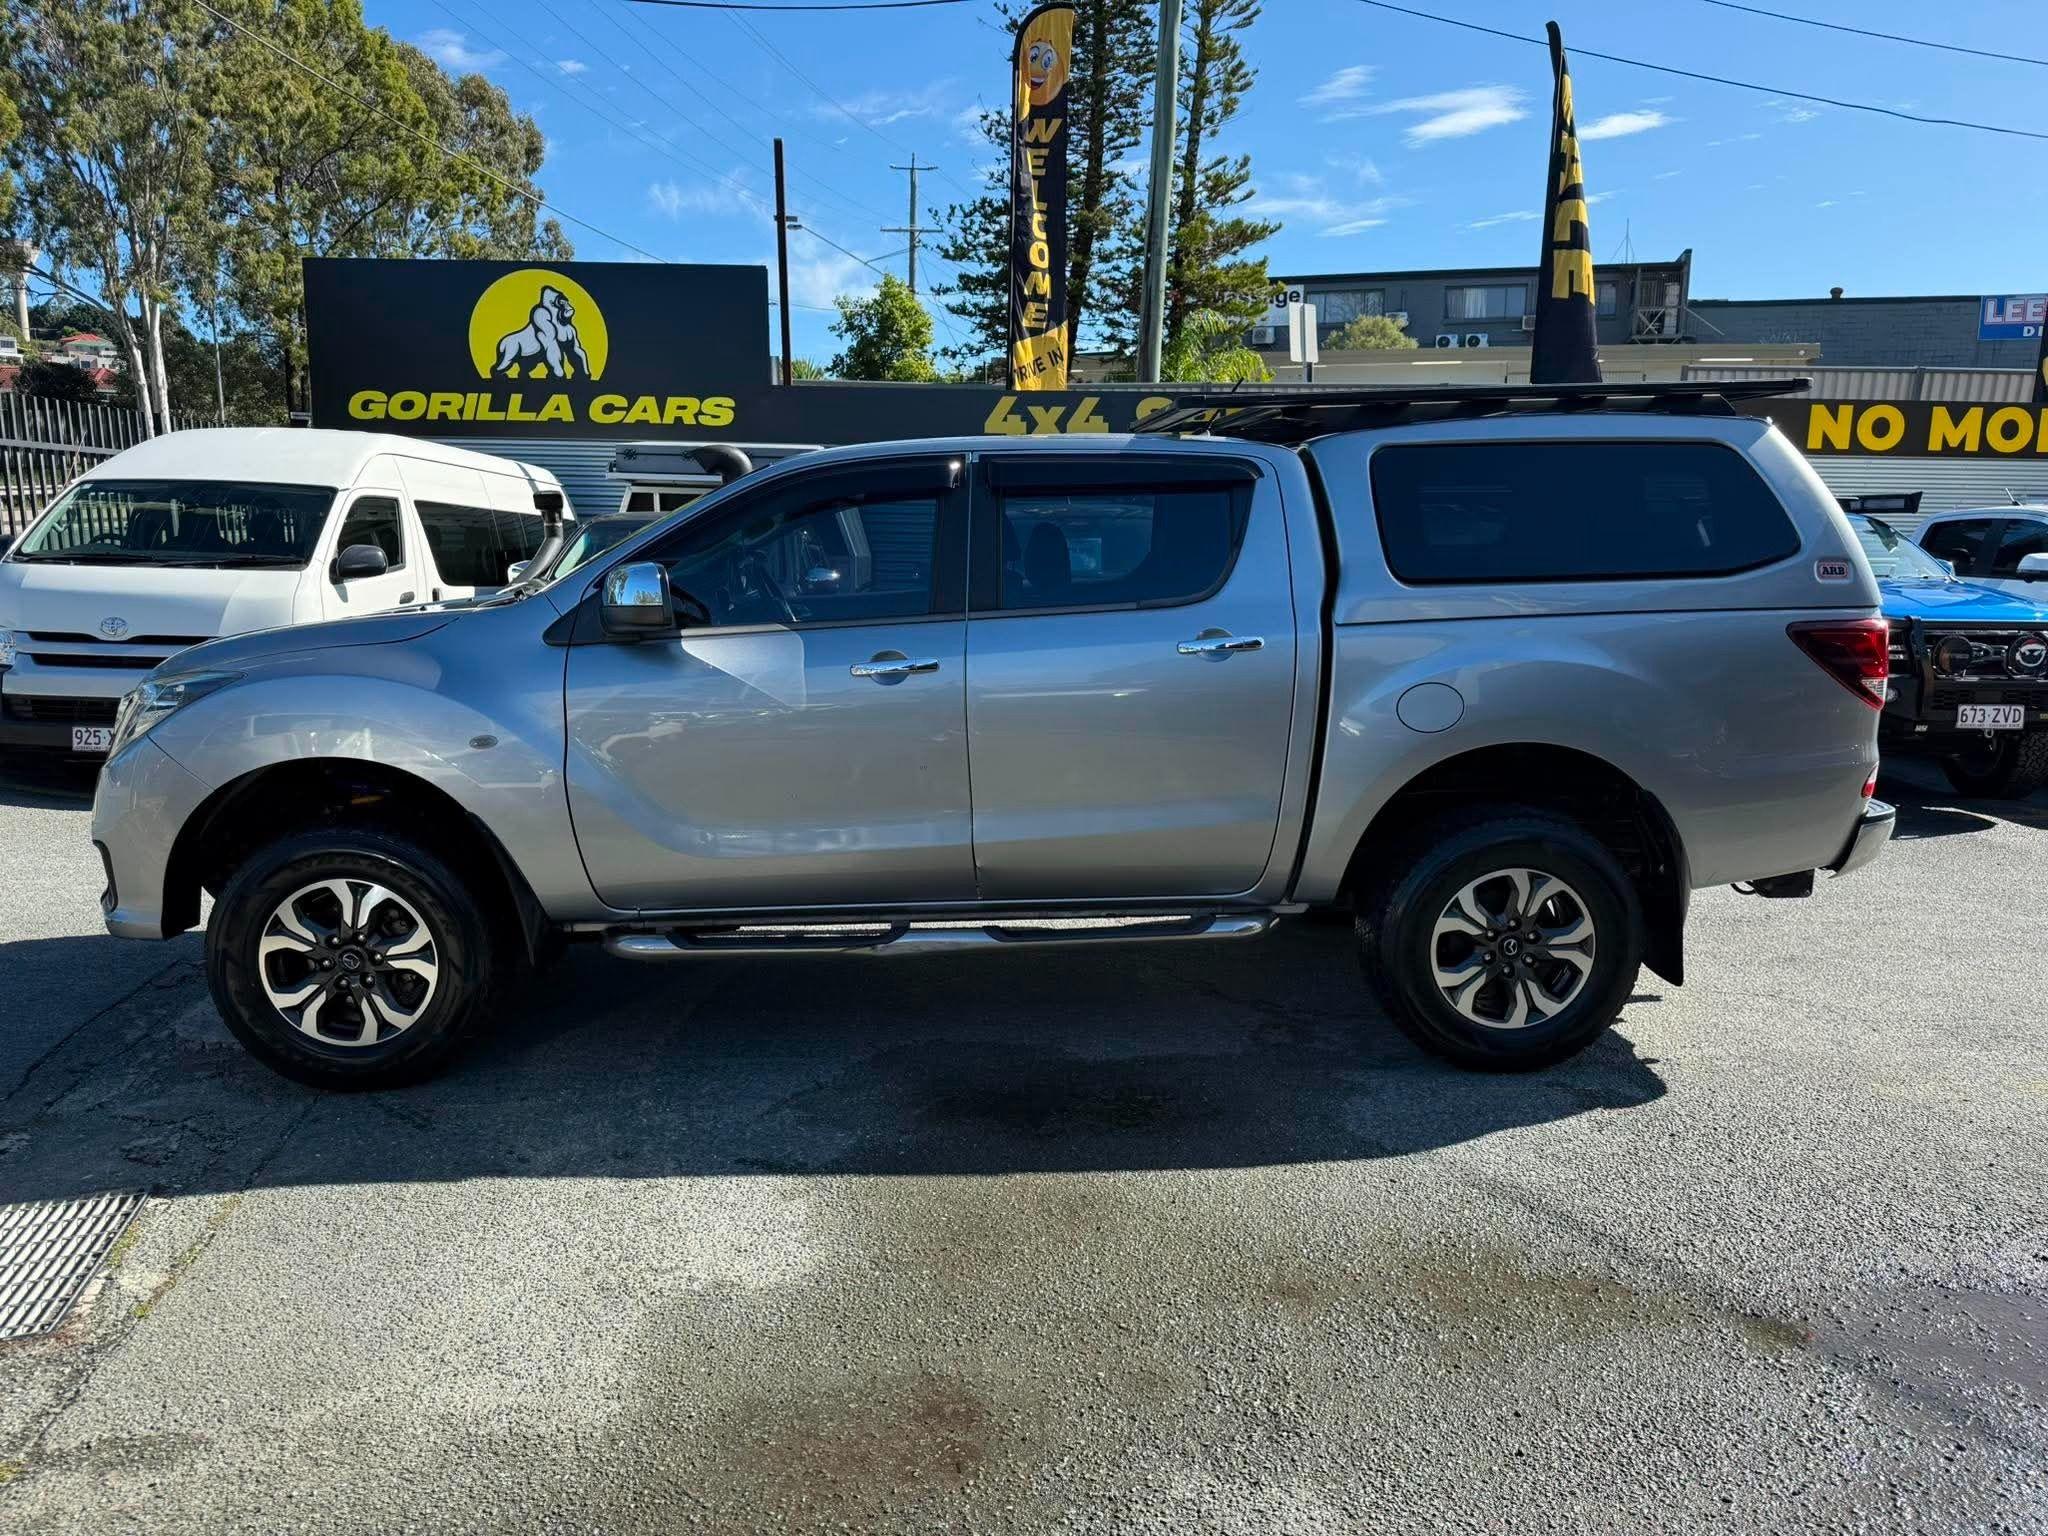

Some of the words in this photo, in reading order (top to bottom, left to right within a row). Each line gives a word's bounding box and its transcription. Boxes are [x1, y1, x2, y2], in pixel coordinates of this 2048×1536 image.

[1023, 118, 1062, 329] WELCOME
[1047, 346, 1064, 367] IN
[348, 390, 575, 422] GORILLA
[588, 394, 737, 427] CARS
[984, 395, 1110, 436] 4x4
[1807, 404, 1905, 451] NO
[1821, 565, 1846, 576] ARB
